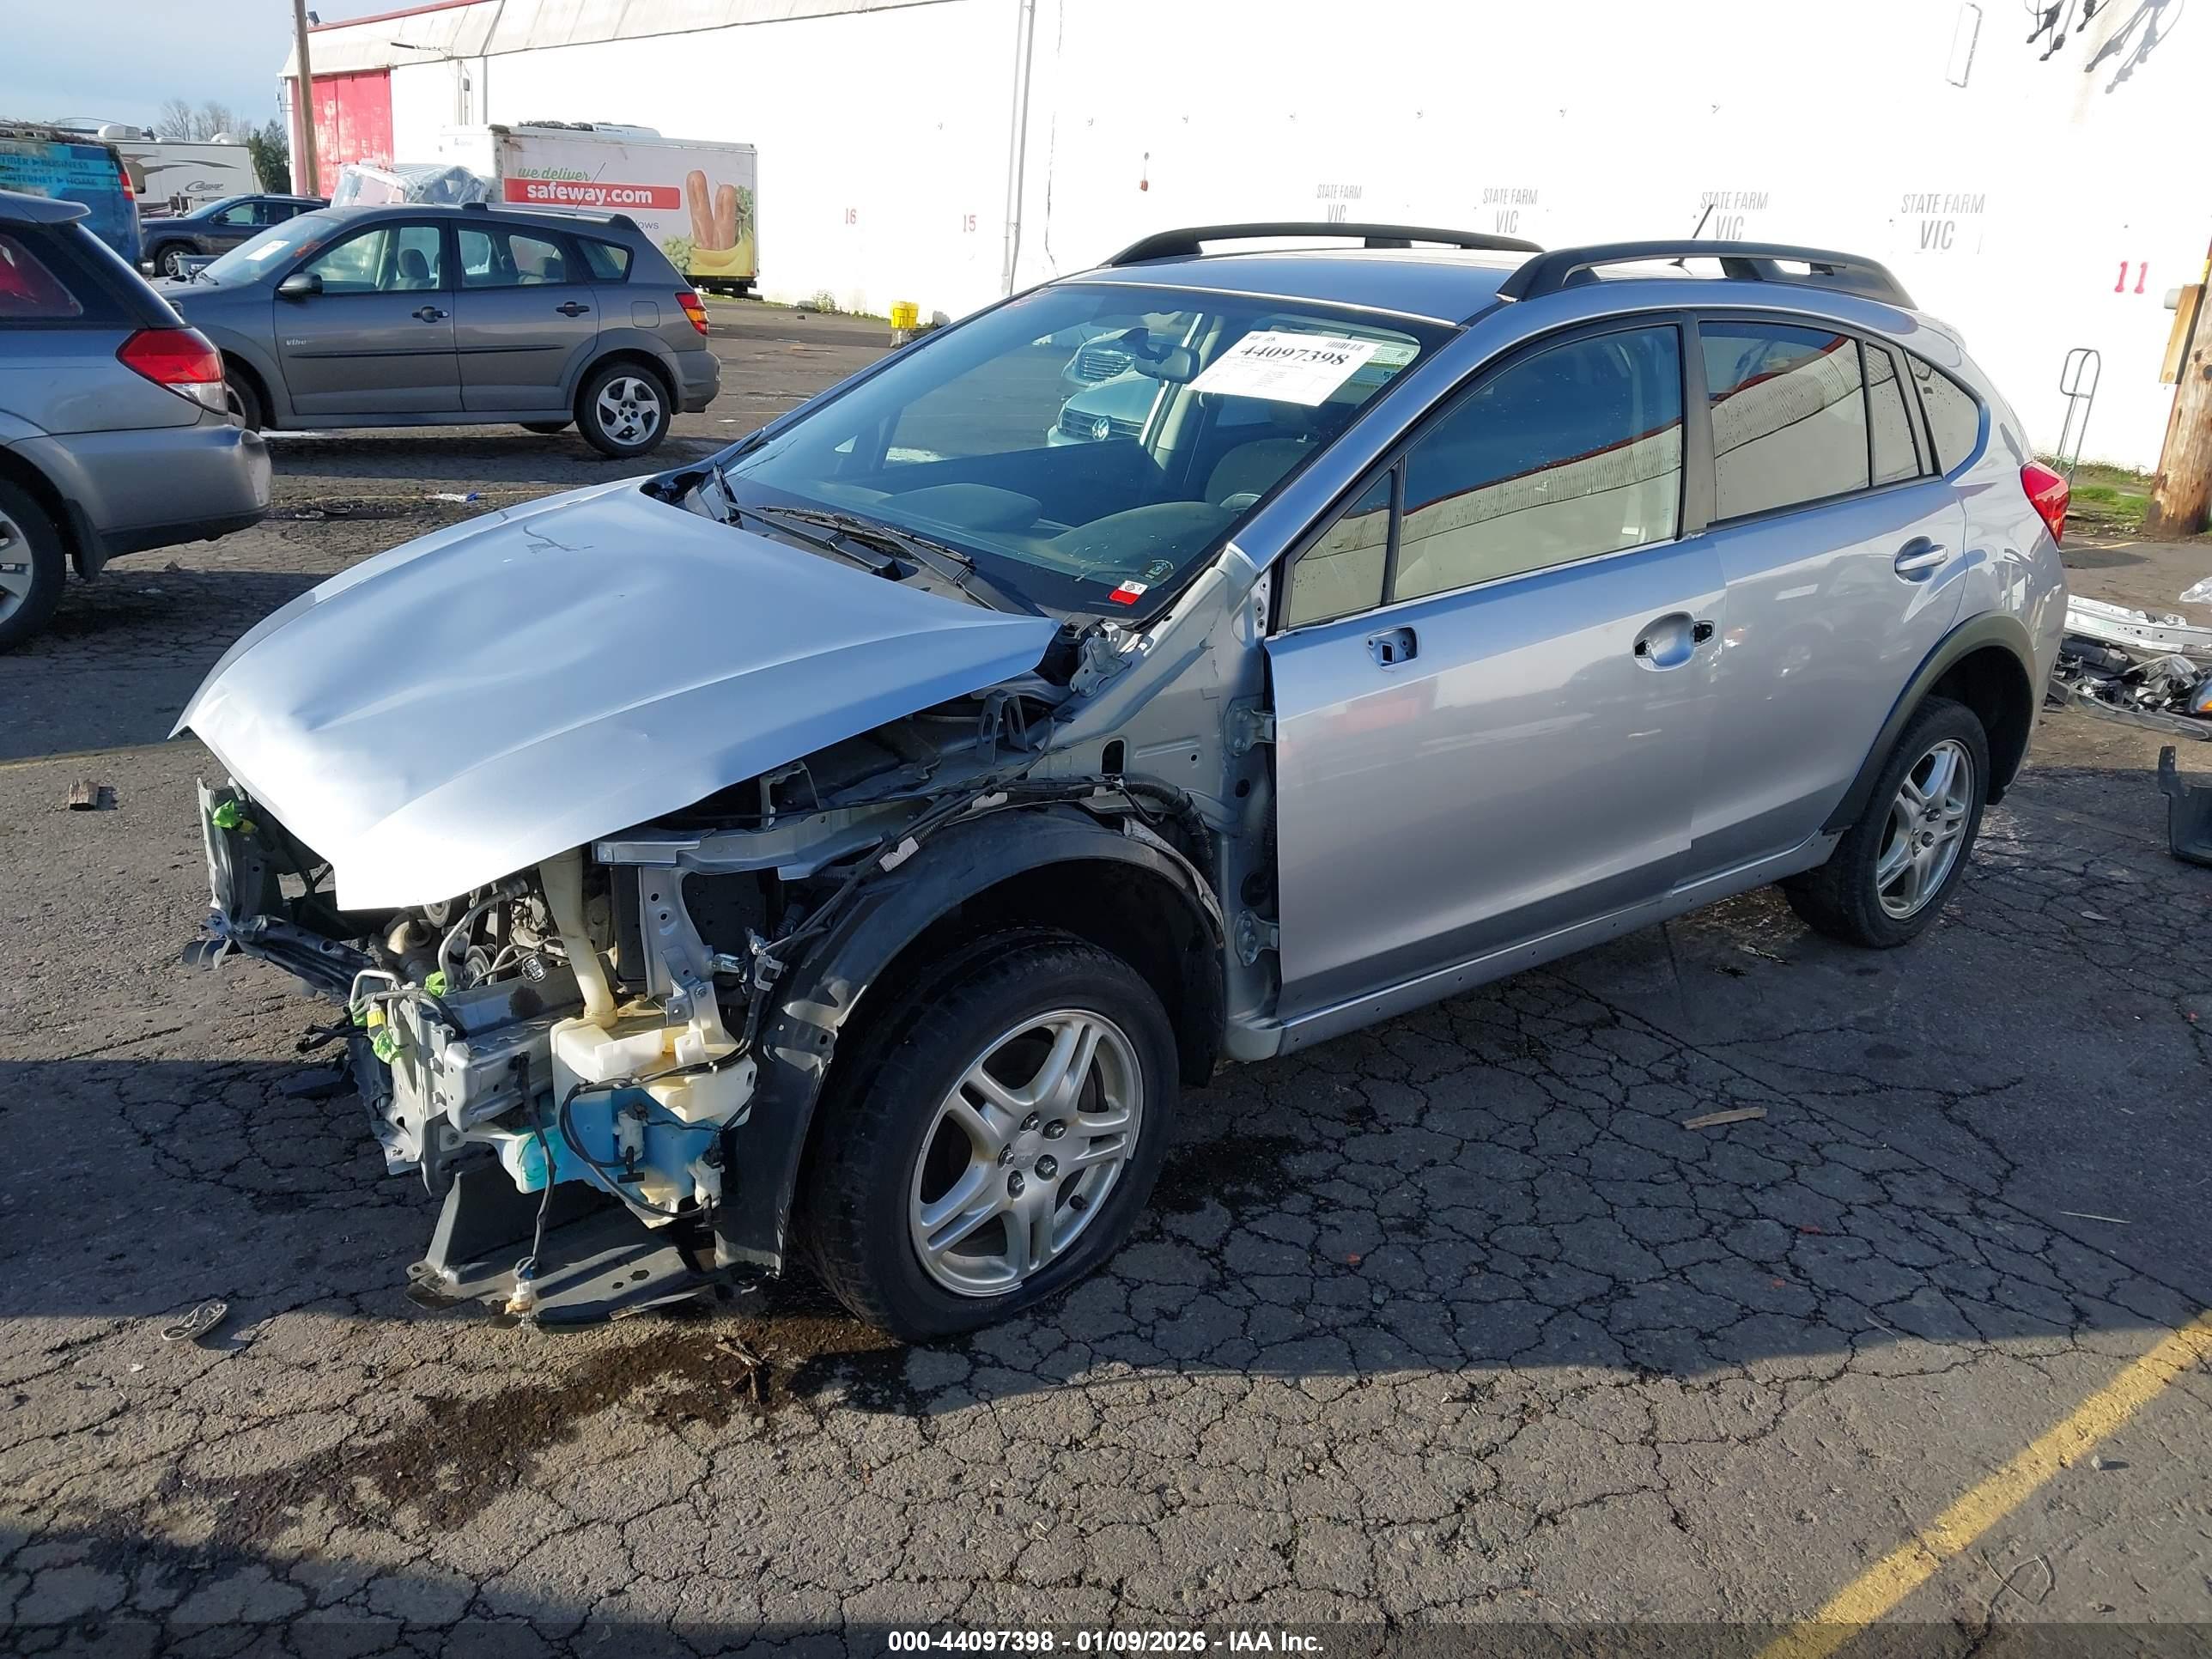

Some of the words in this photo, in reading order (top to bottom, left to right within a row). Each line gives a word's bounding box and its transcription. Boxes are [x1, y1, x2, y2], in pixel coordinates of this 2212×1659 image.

[518, 167, 540, 179] we
[541, 167, 591, 182] deliver
[526, 181, 653, 206] safeway.com
[1316, 184, 1338, 199] STATE
[1340, 185, 1362, 200] FARM
[1483, 188, 1508, 204] STATE
[1510, 189, 1538, 205] FARM
[1700, 191, 1731, 209] STATE
[1734, 192, 1768, 210] FARM
[1327, 204, 1346, 222] VIC
[1901, 193, 1941, 214] STATE
[1943, 194, 1985, 214] FARM
[635, 220, 659, 229] ows
[845, 208, 857, 225] 16
[963, 214, 976, 233] 15
[1496, 210, 1519, 234] VIC
[1716, 216, 1744, 240] VIC
[1920, 220, 1955, 250] VIC
[2113, 260, 2148, 295] 11
[1240, 344, 1351, 367] 44097398
